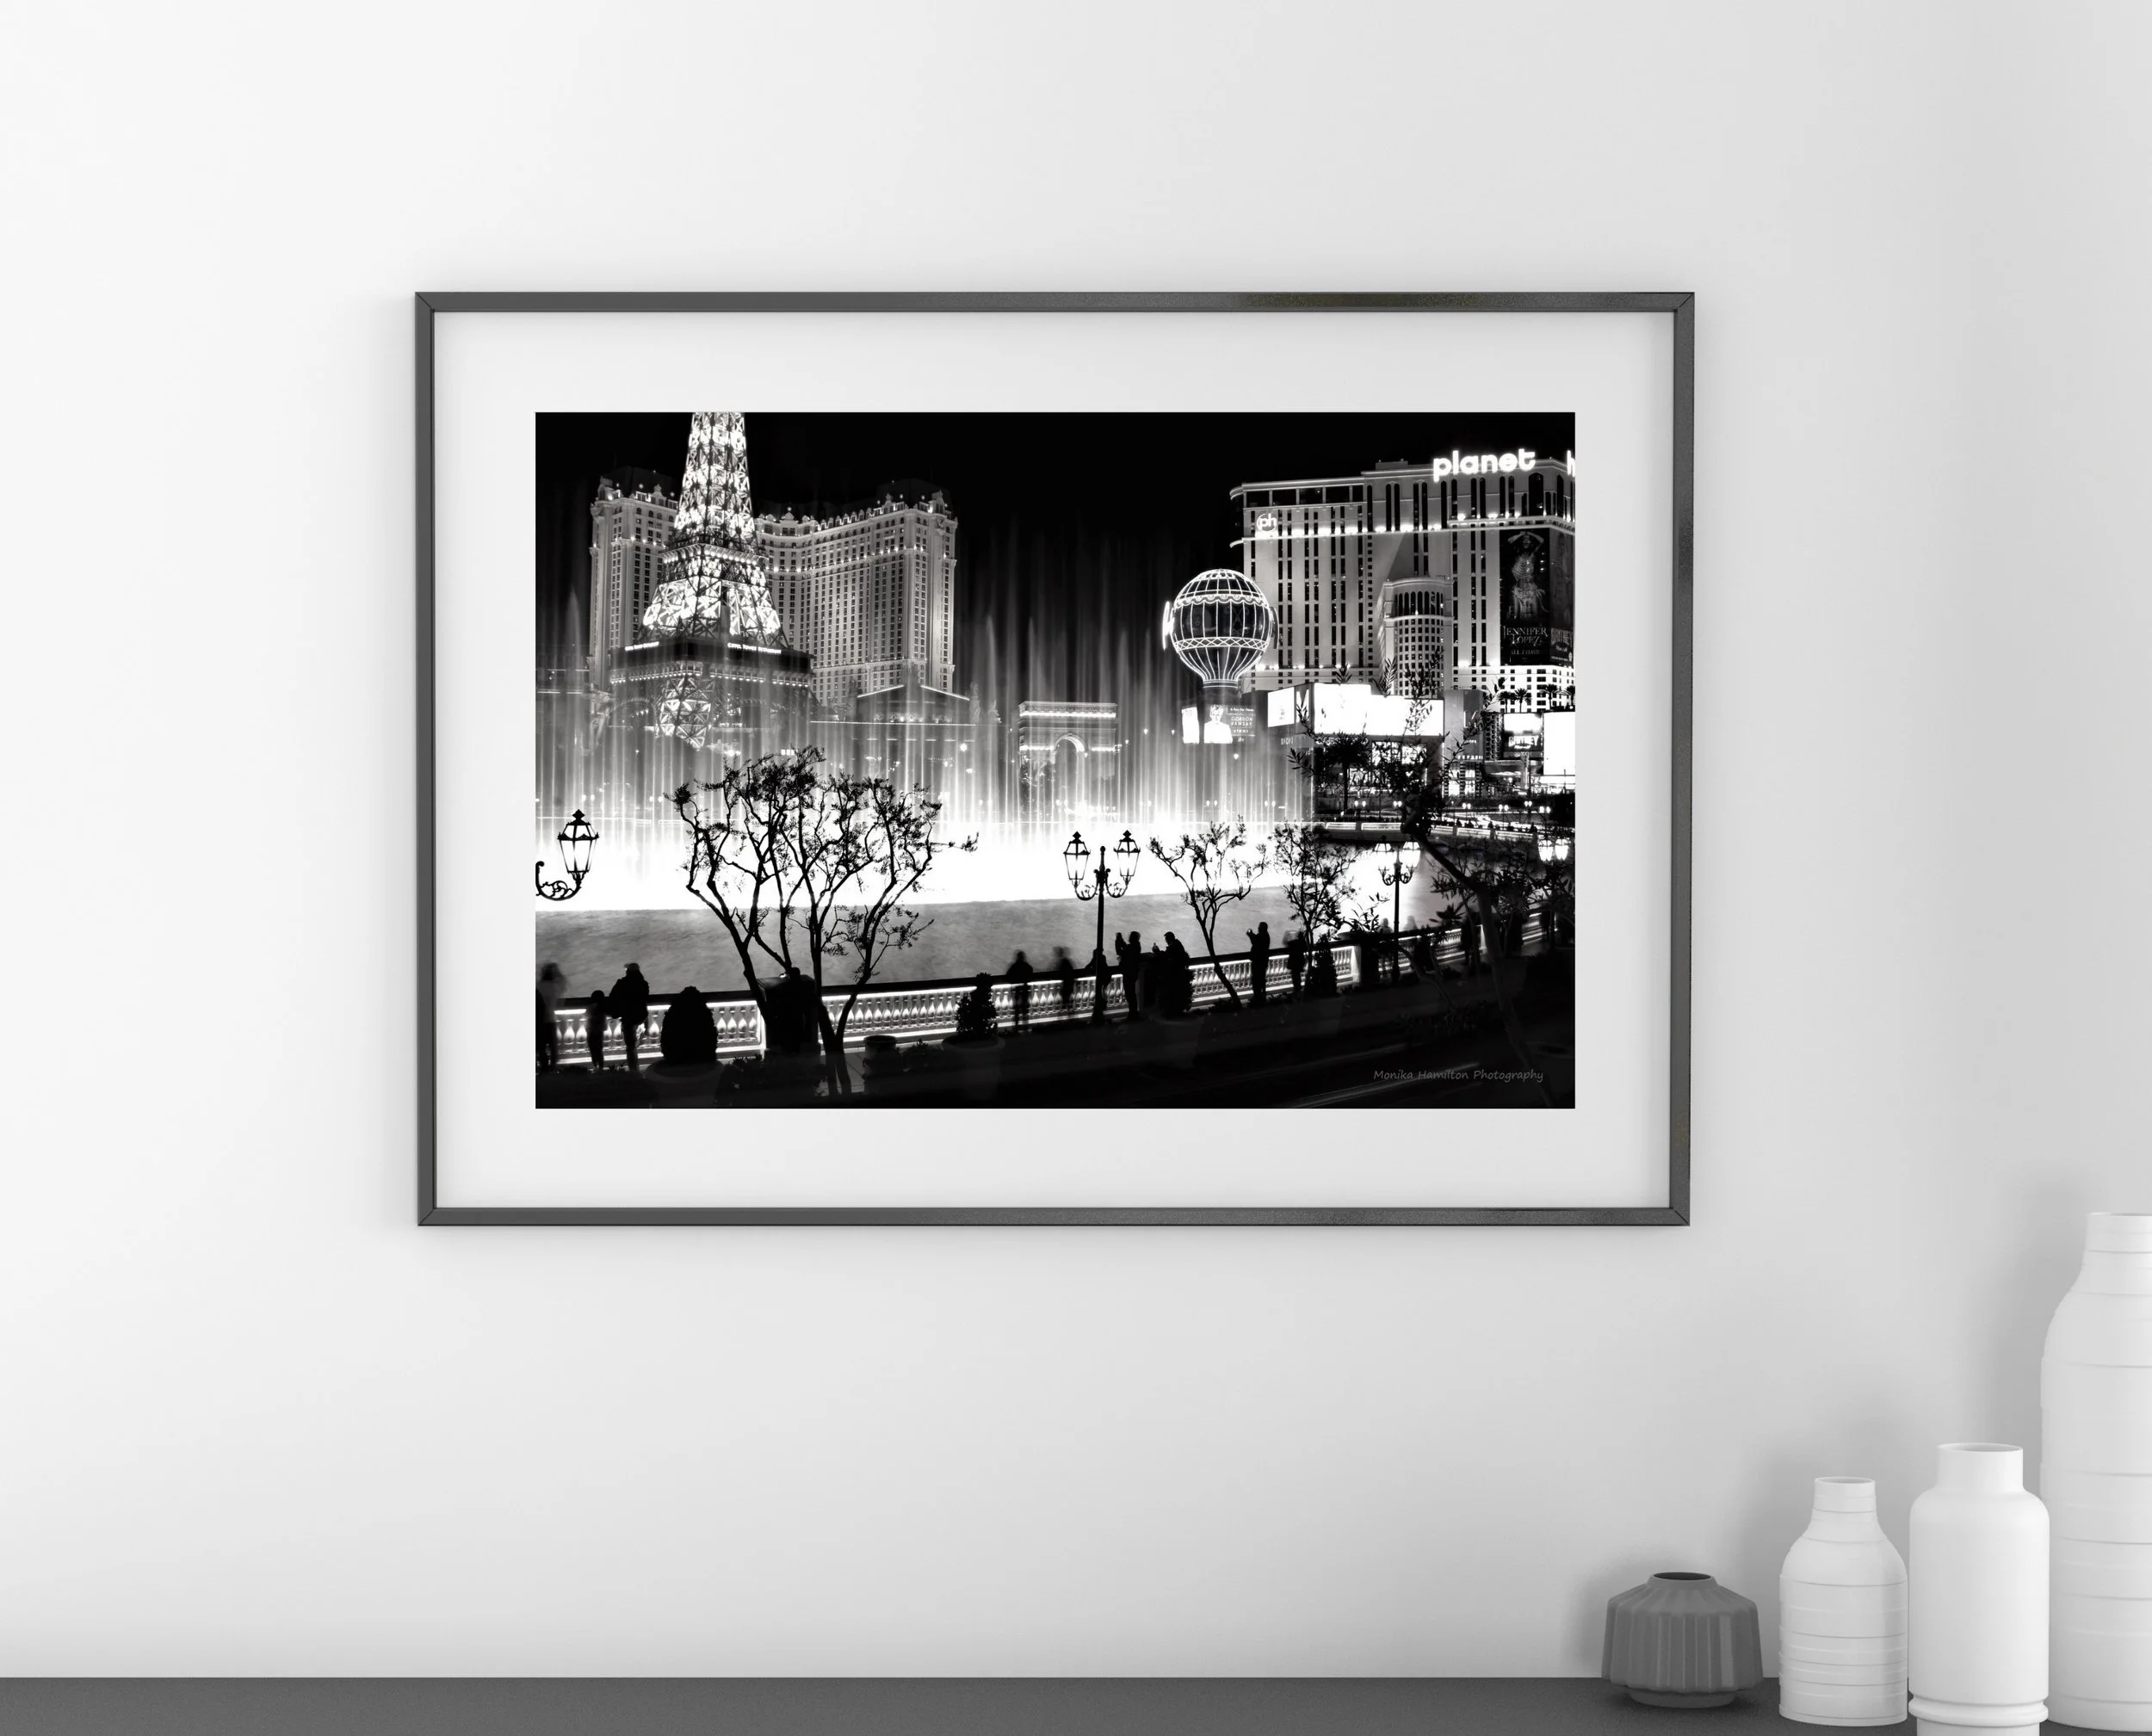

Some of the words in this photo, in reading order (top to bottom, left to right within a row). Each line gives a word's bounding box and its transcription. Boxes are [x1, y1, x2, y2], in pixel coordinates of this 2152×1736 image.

[1433, 448, 1537, 483] planet
[1503, 626, 1549, 639] JENNIFER
[1509, 634, 1543, 647] LOPEZ
